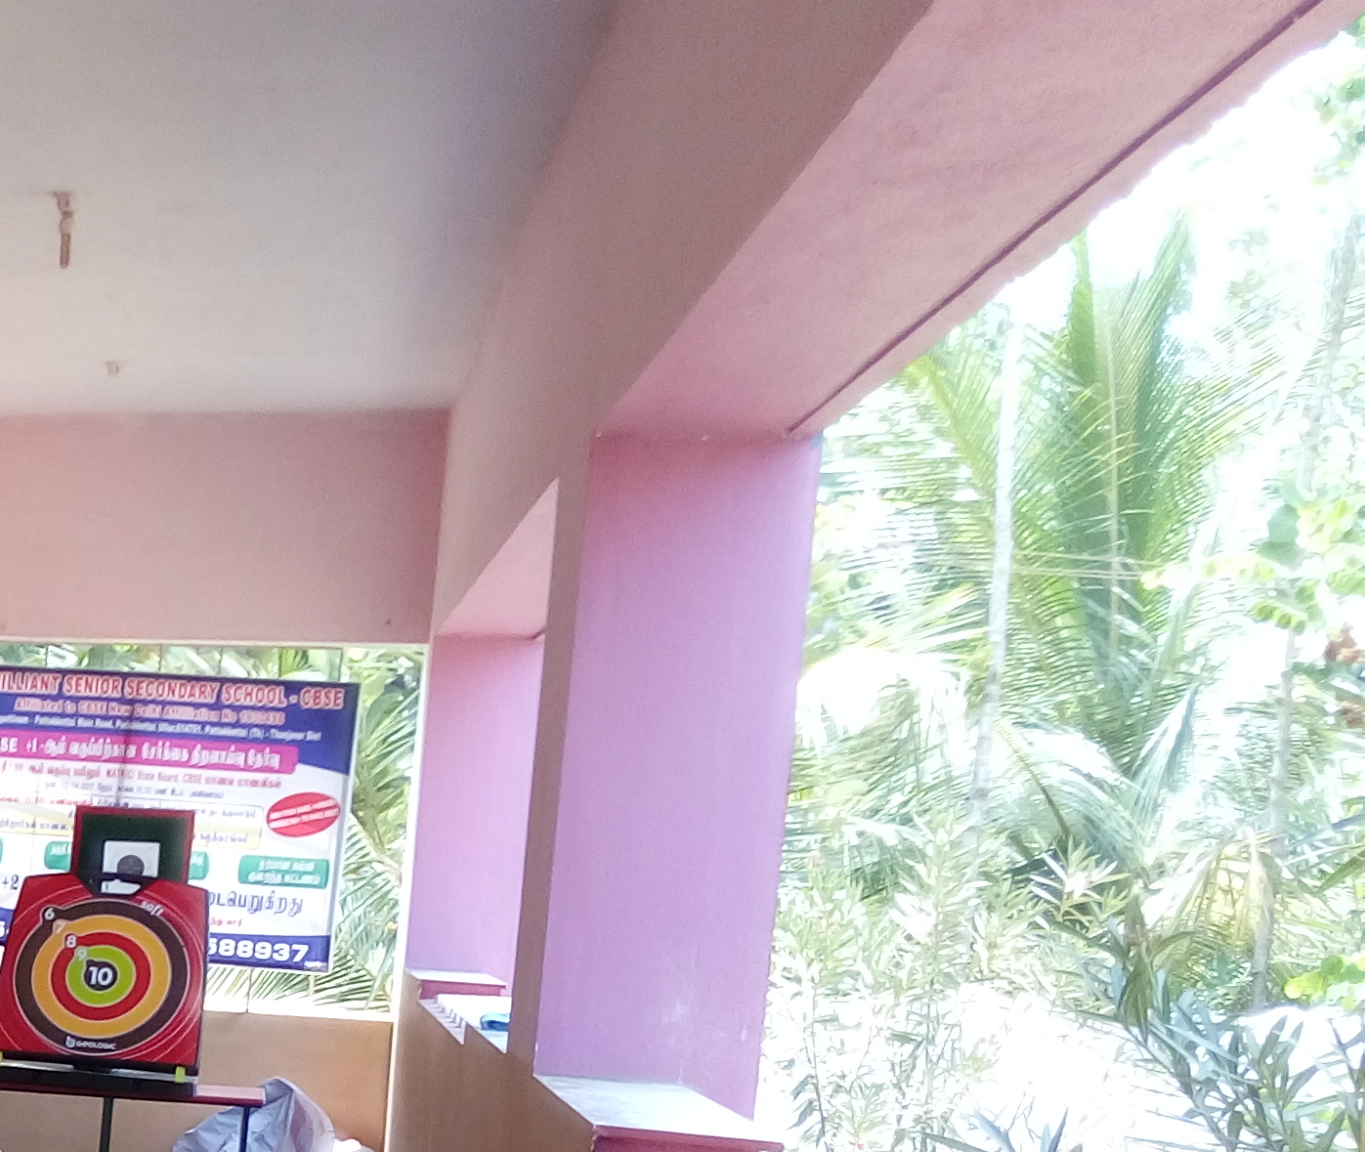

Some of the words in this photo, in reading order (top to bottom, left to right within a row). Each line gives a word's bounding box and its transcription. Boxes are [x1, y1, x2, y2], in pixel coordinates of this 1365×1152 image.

[63, 674, 123, 697] SENIOR
[124, 677, 220, 704] SECONDARY
[221, 683, 287, 707] SCHOOL
[300, 687, 344, 709] CBSE
[2, 874, 19, 890] +2
[45, 908, 54, 920] 6
[55, 921, 66, 933] 7
[66, 935, 76, 947] 8
[88, 966, 113, 986] 10
